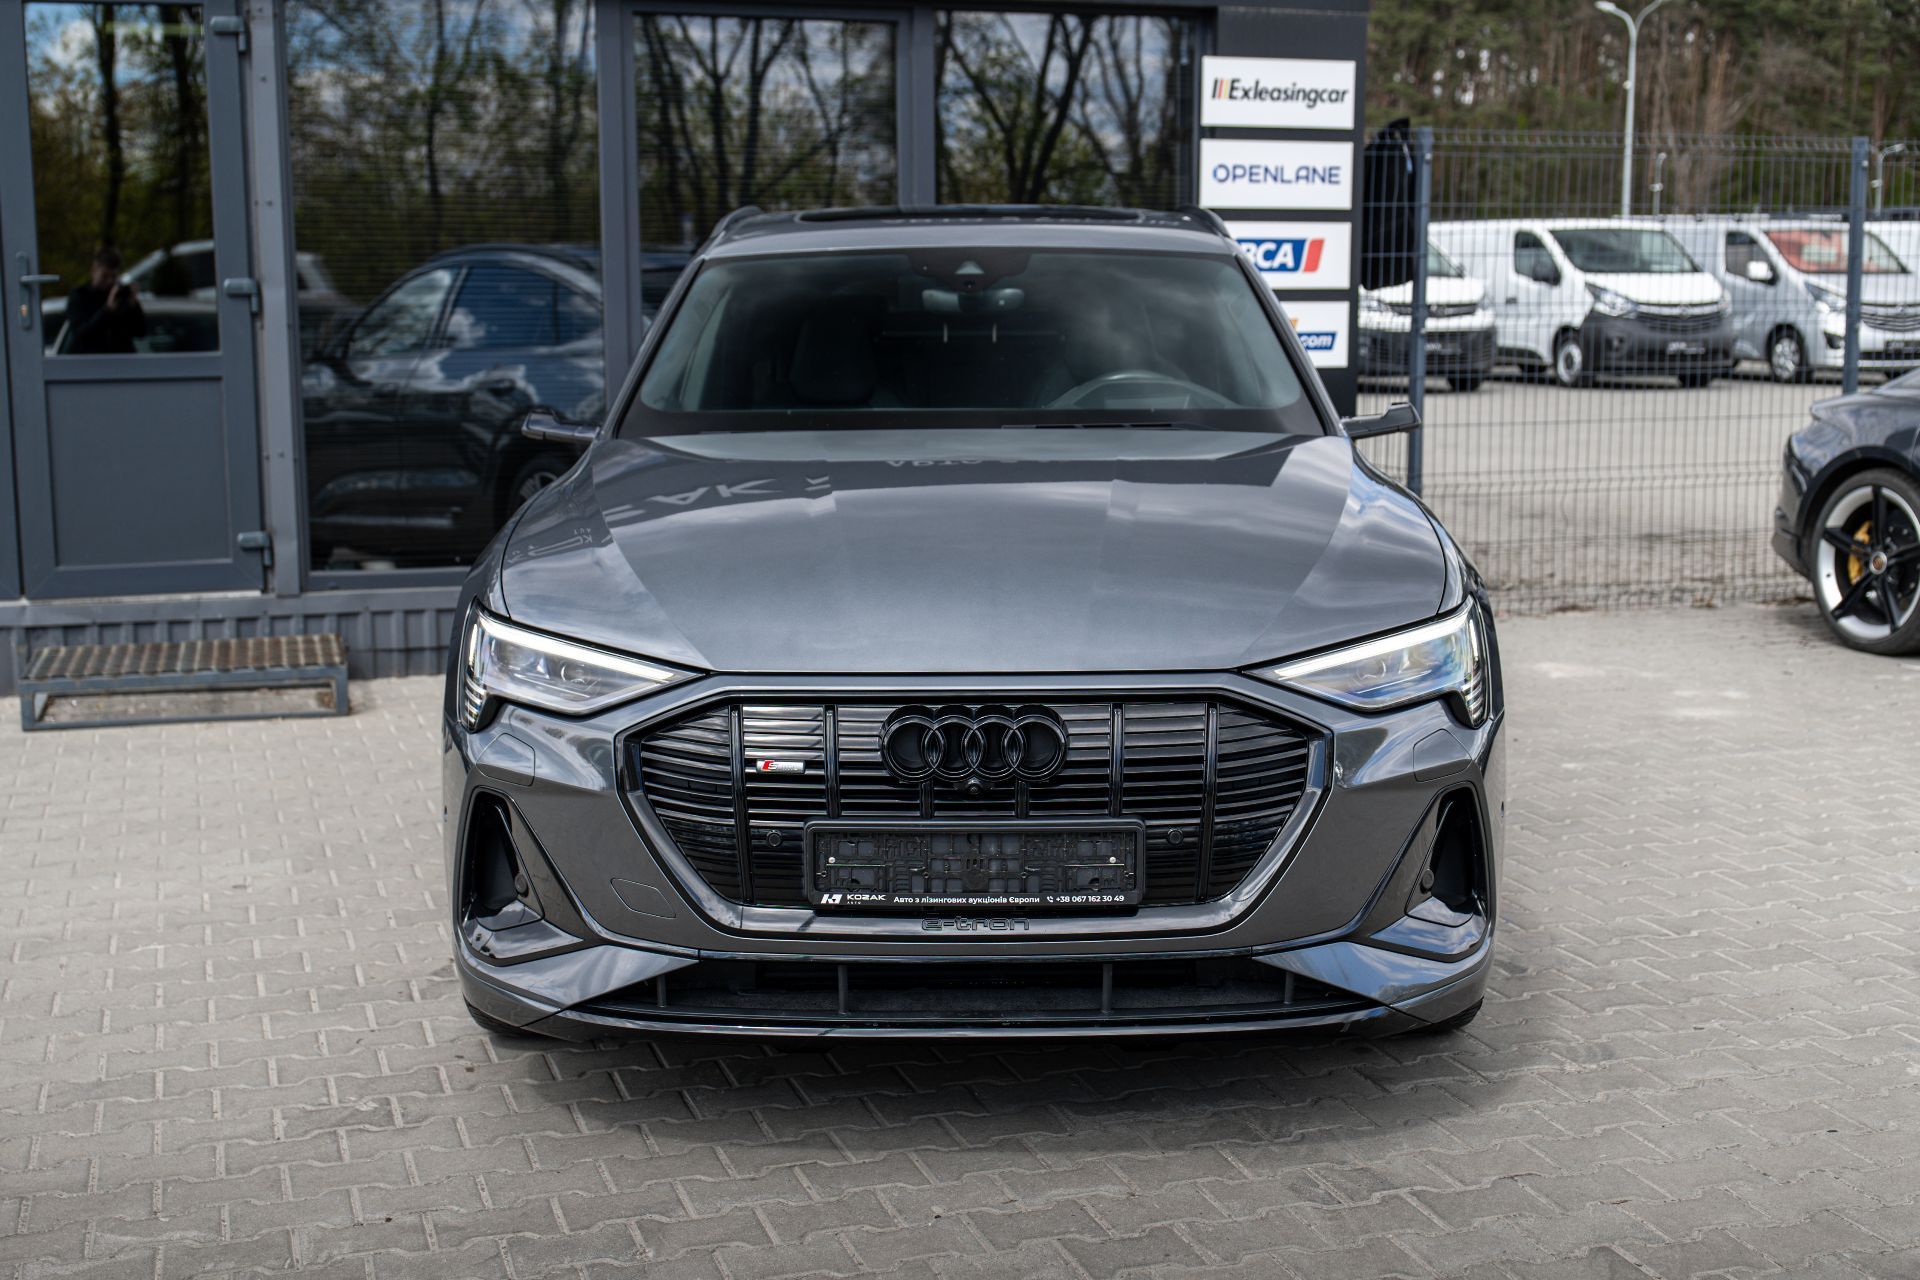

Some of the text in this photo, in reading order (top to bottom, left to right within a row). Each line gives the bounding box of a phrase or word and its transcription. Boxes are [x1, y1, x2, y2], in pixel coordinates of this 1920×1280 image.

[1229, 78, 1348, 109] Exleasingcar
[1212, 163, 1341, 185] OPENLANE
[893, 896, 914, 904] Авто
[920, 895, 967, 905] лізингових
[967, 895, 1008, 905] аукціонів
[1008, 896, 1041, 905] Європи
[1071, 895, 1087, 903] 067
[1087, 895, 1102, 903] 162
[921, 915, 1030, 931] e-tron
